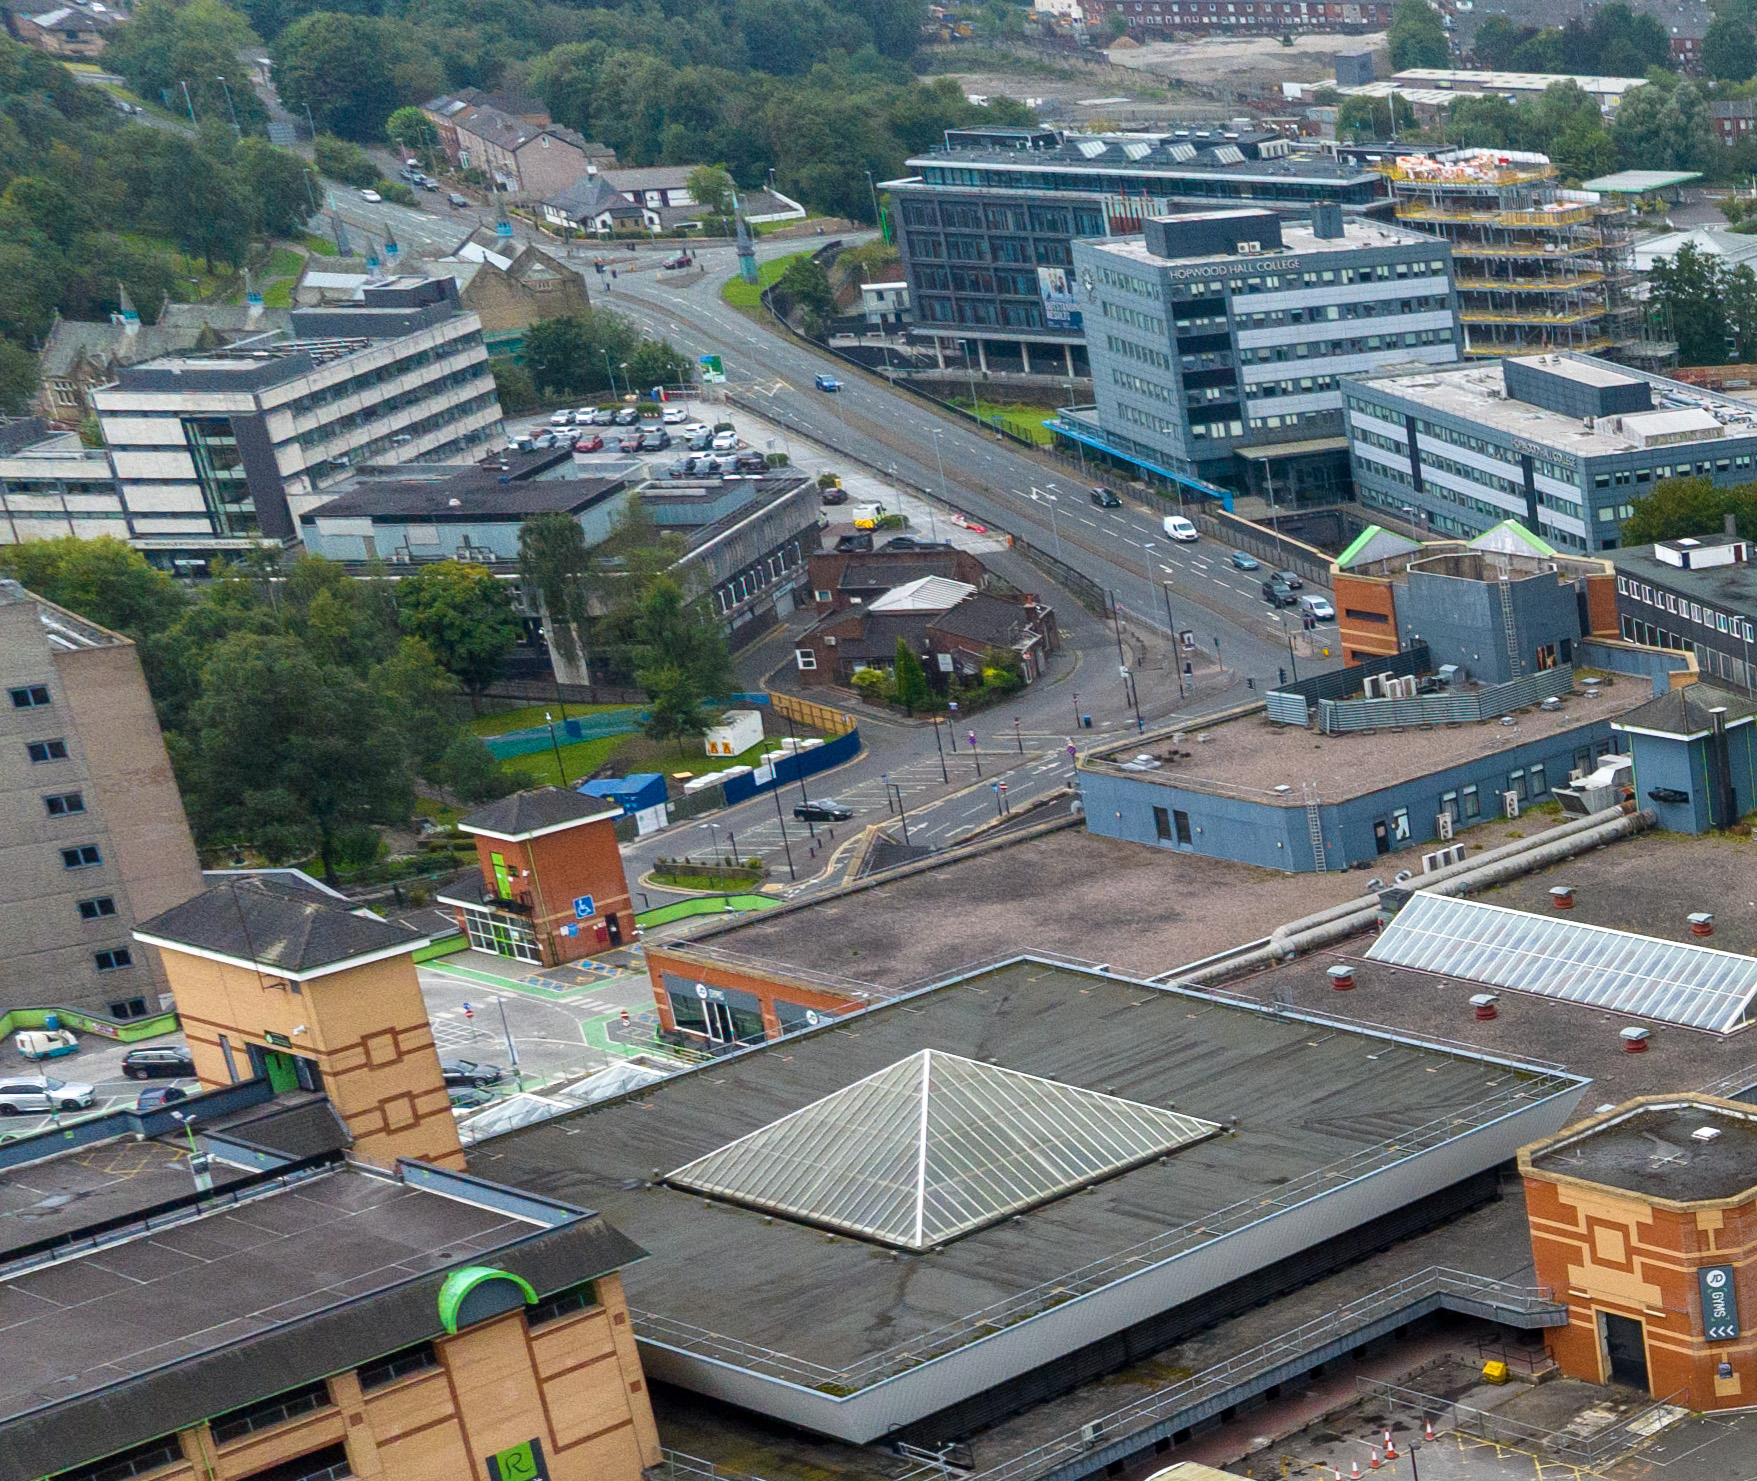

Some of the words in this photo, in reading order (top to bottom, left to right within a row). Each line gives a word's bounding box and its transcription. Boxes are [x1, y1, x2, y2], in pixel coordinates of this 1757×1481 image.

[1169, 265, 1227, 280] HOPWOOD
[1229, 262, 1254, 275] HALL
[1256, 258, 1301, 272] COLLEGE
[1711, 1291, 1727, 1318] GYMS
